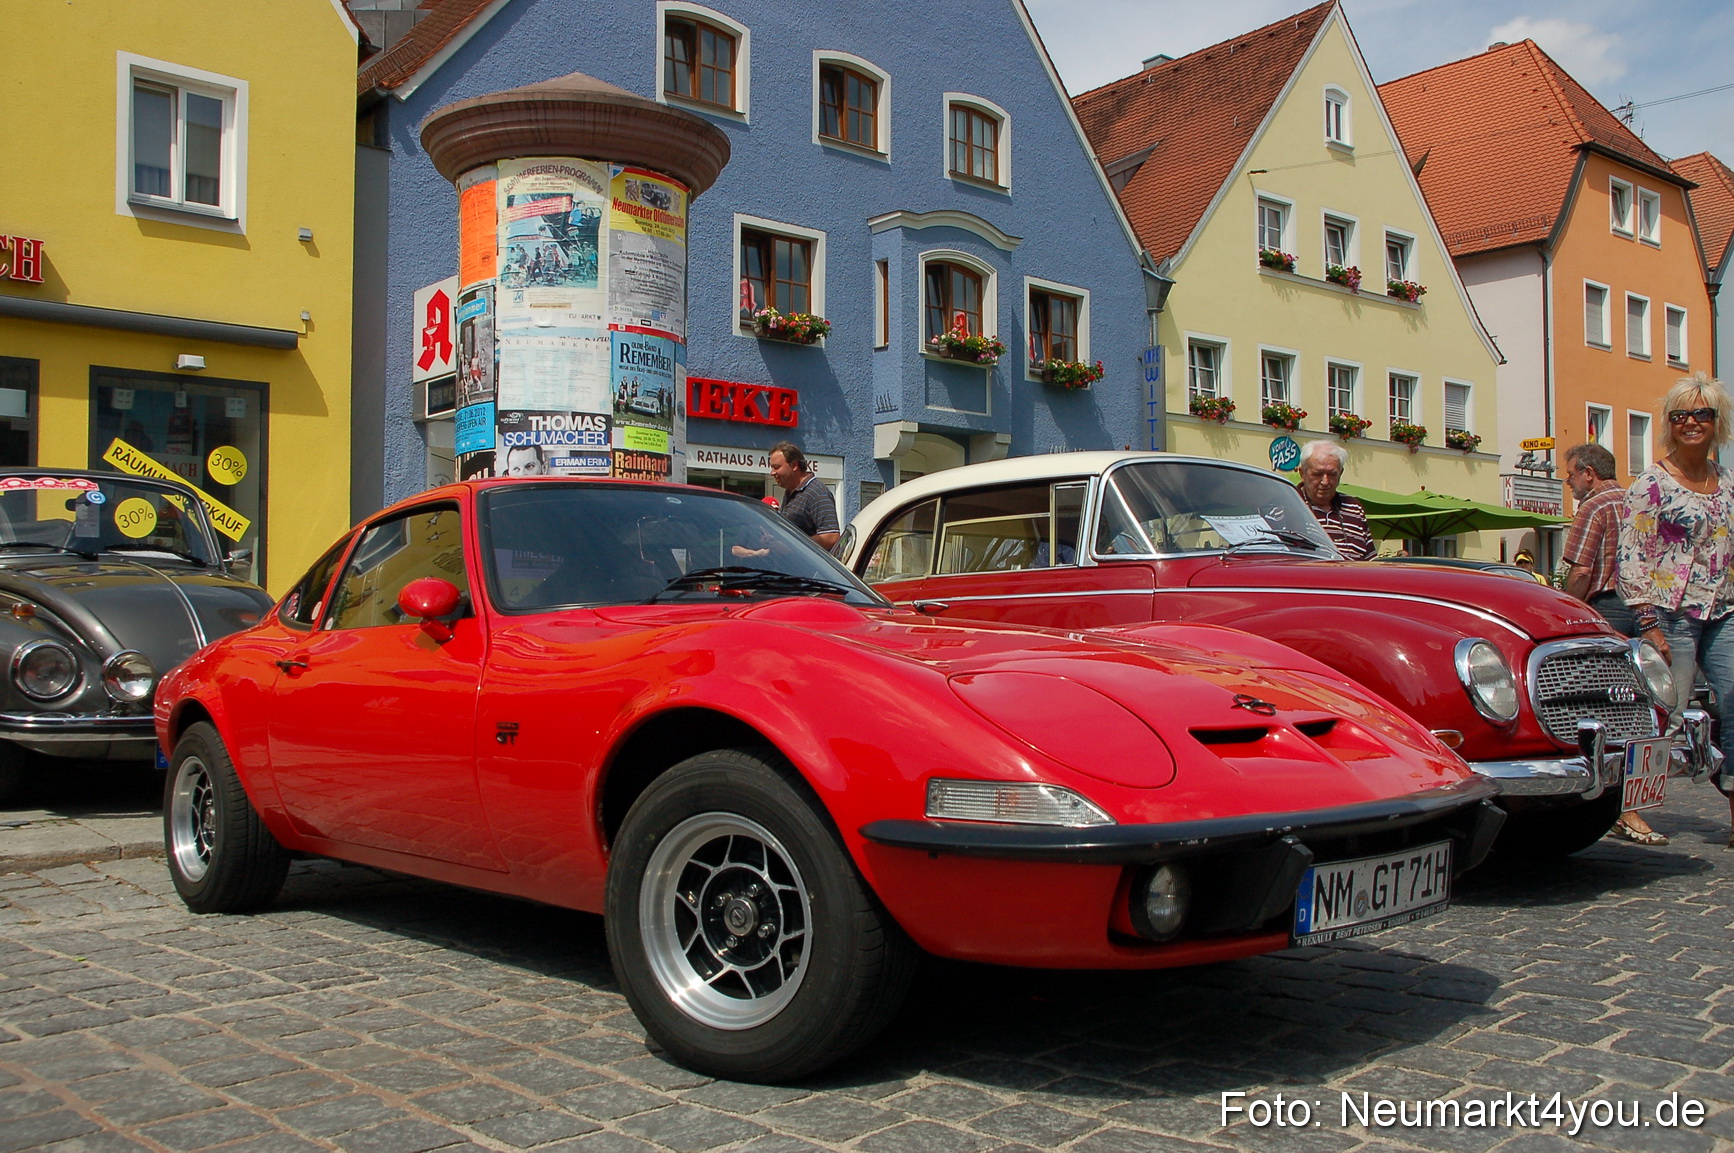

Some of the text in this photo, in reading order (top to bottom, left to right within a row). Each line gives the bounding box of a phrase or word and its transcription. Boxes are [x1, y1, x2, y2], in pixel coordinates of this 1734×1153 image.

[612, 197, 653, 220] Neumarkter
[1145, 366, 1159, 451] WITTL
[528, 415, 606, 431] THOMAS
[505, 431, 605, 446] SCHUMACHER
[1523, 440, 1539, 449] KINO
[211, 453, 243, 478] 30%
[555, 458, 607, 467] ERMAN ERIM
[615, 451, 667, 473] Rainhard
[697, 450, 753, 466] RATHAUS
[1272, 443, 1297, 470] FASS
[118, 504, 155, 529] 30%
[496, 731, 519, 744] GT
[1641, 744, 1652, 774] R
[1624, 773, 1666, 808] 07642
[1314, 849, 1448, 924] NM GT 71H
[1298, 908, 1306, 923] D
[1302, 932, 1333, 947] RENAULT
[1353, 922, 1382, 936] PETERSEN
